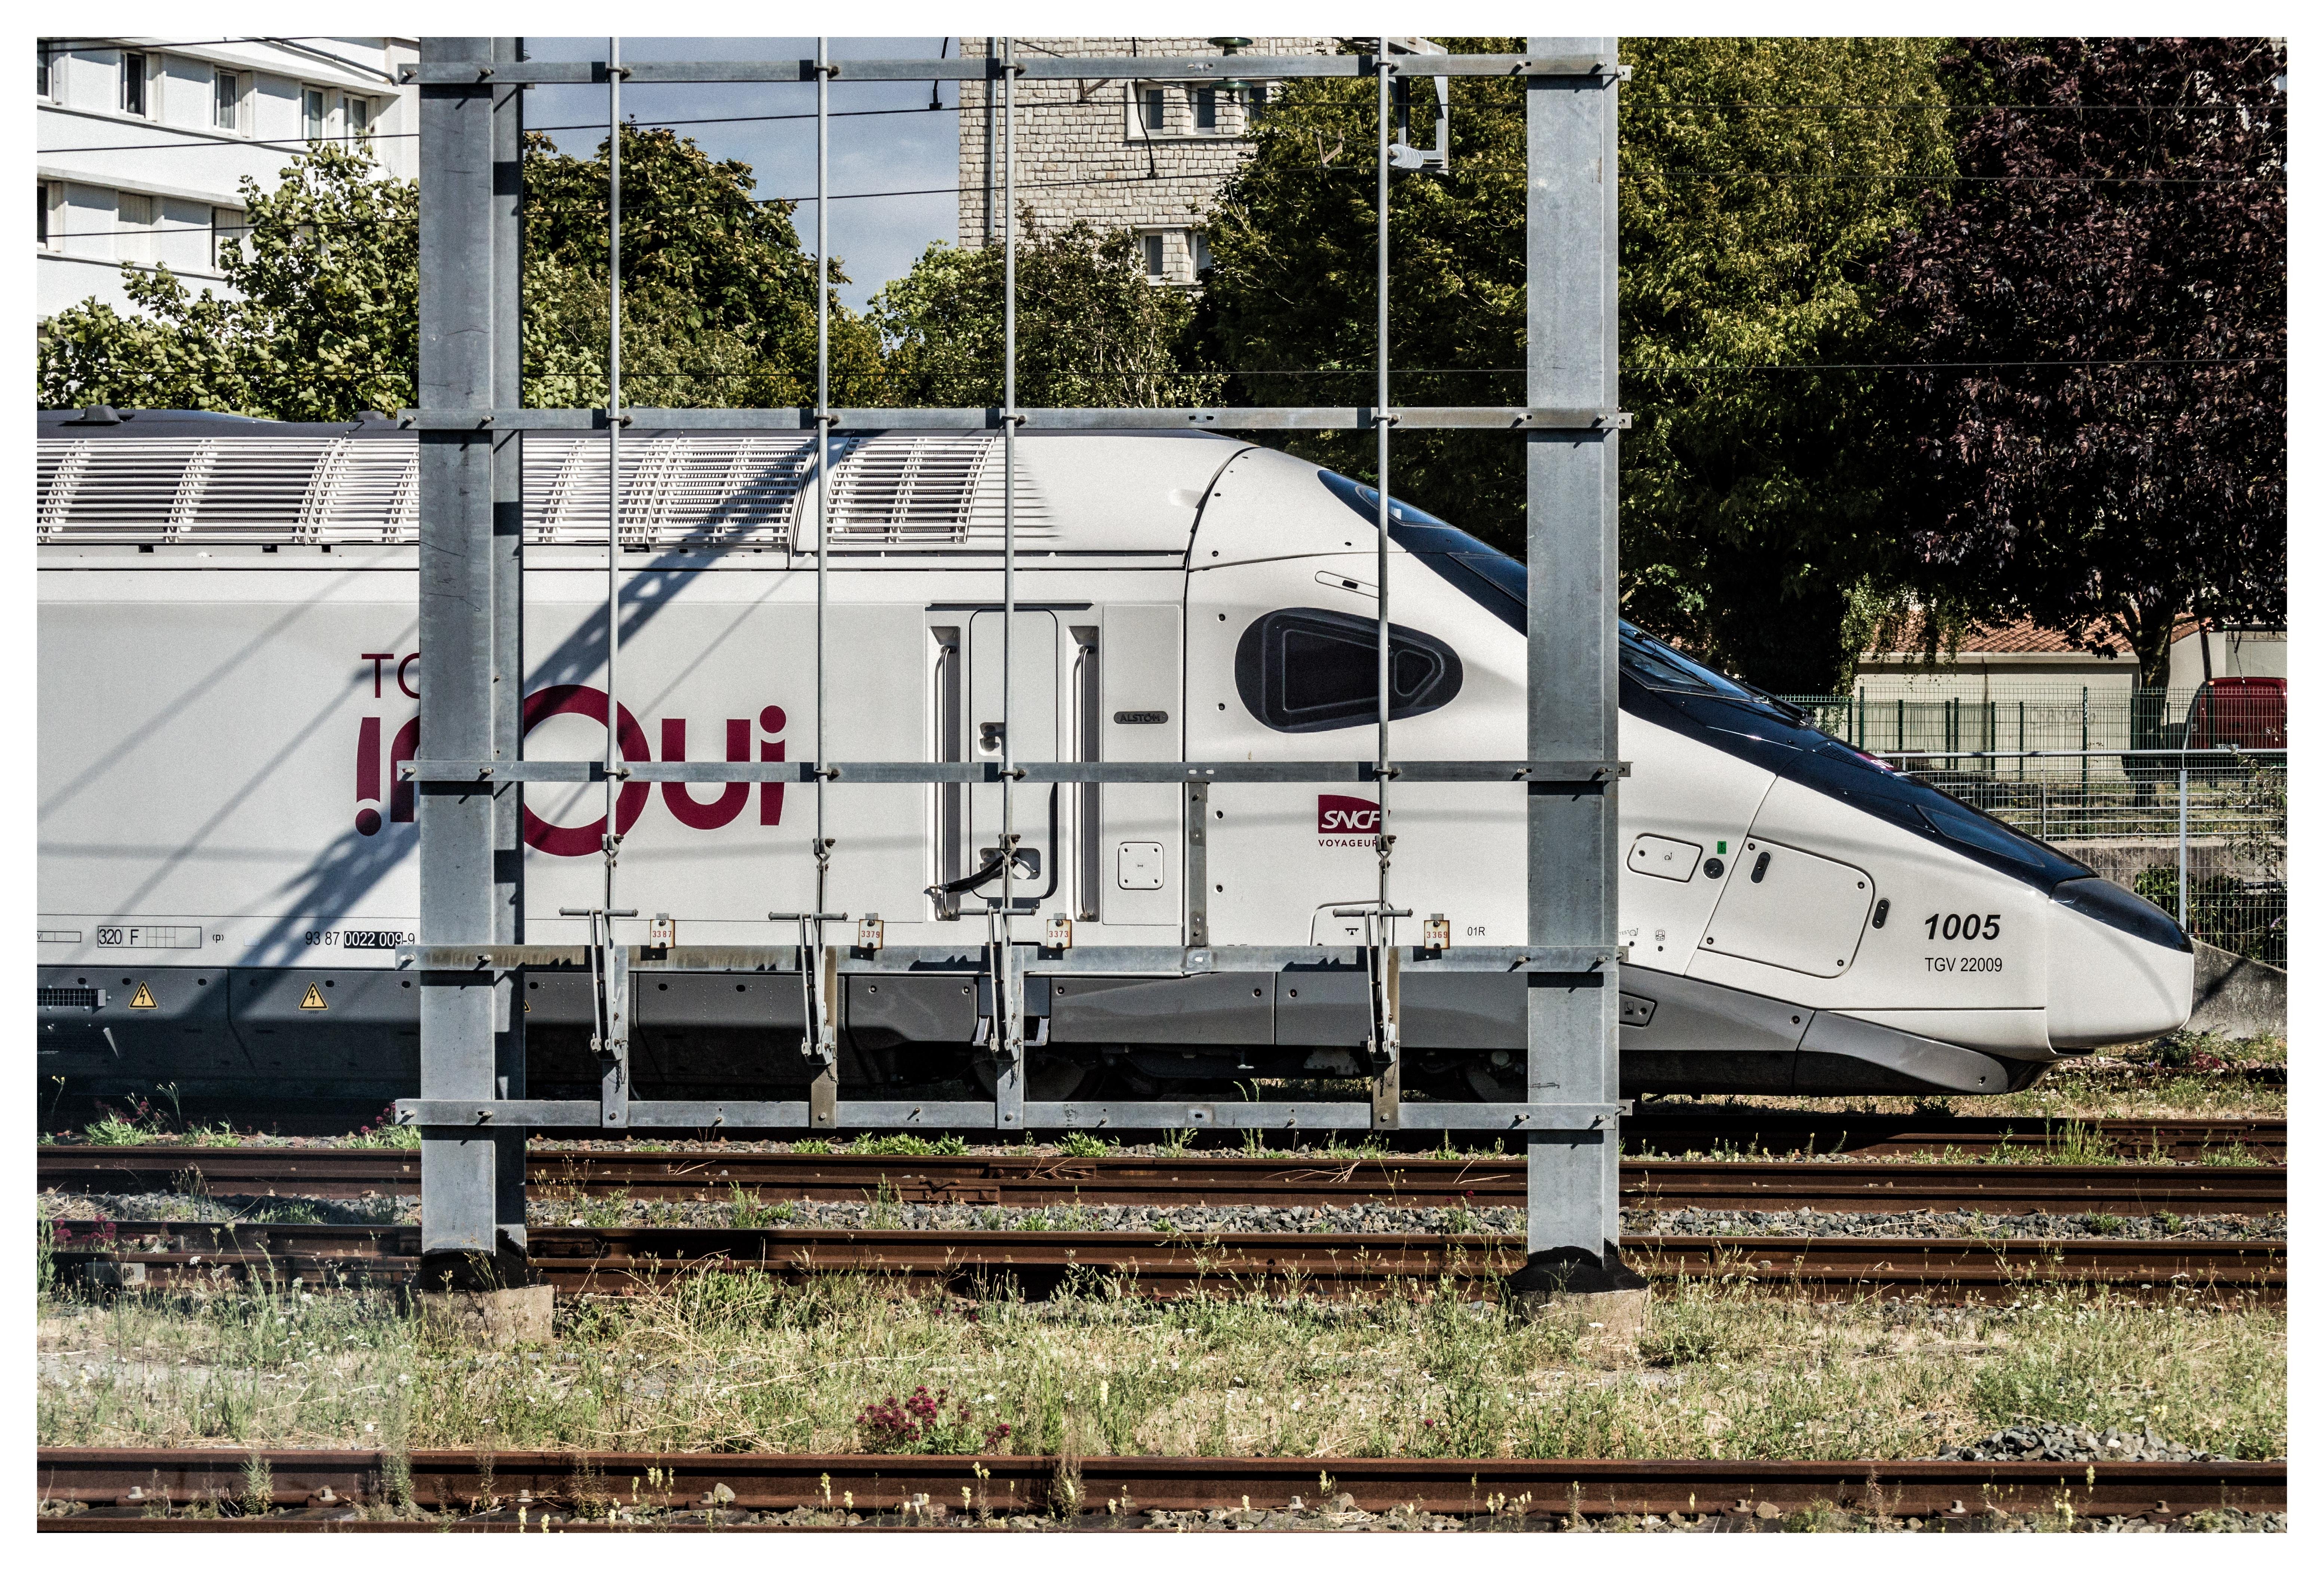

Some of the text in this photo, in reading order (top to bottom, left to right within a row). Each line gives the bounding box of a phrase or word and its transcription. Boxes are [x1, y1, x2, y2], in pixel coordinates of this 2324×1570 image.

[1120, 713, 1161, 722] ALSTOM
[1321, 810, 1380, 829] SNCF
[1467, 927, 1485, 936] 01R
[1925, 913, 2001, 940] 1005
[99, 929, 139, 945] 320 F
[212, 934, 224, 943] (p)
[305, 931, 321, 945] 93
[325, 932, 340, 945] 87
[344, 932, 375, 946] 0022
[1925, 957, 2002, 972] TGV 22009
